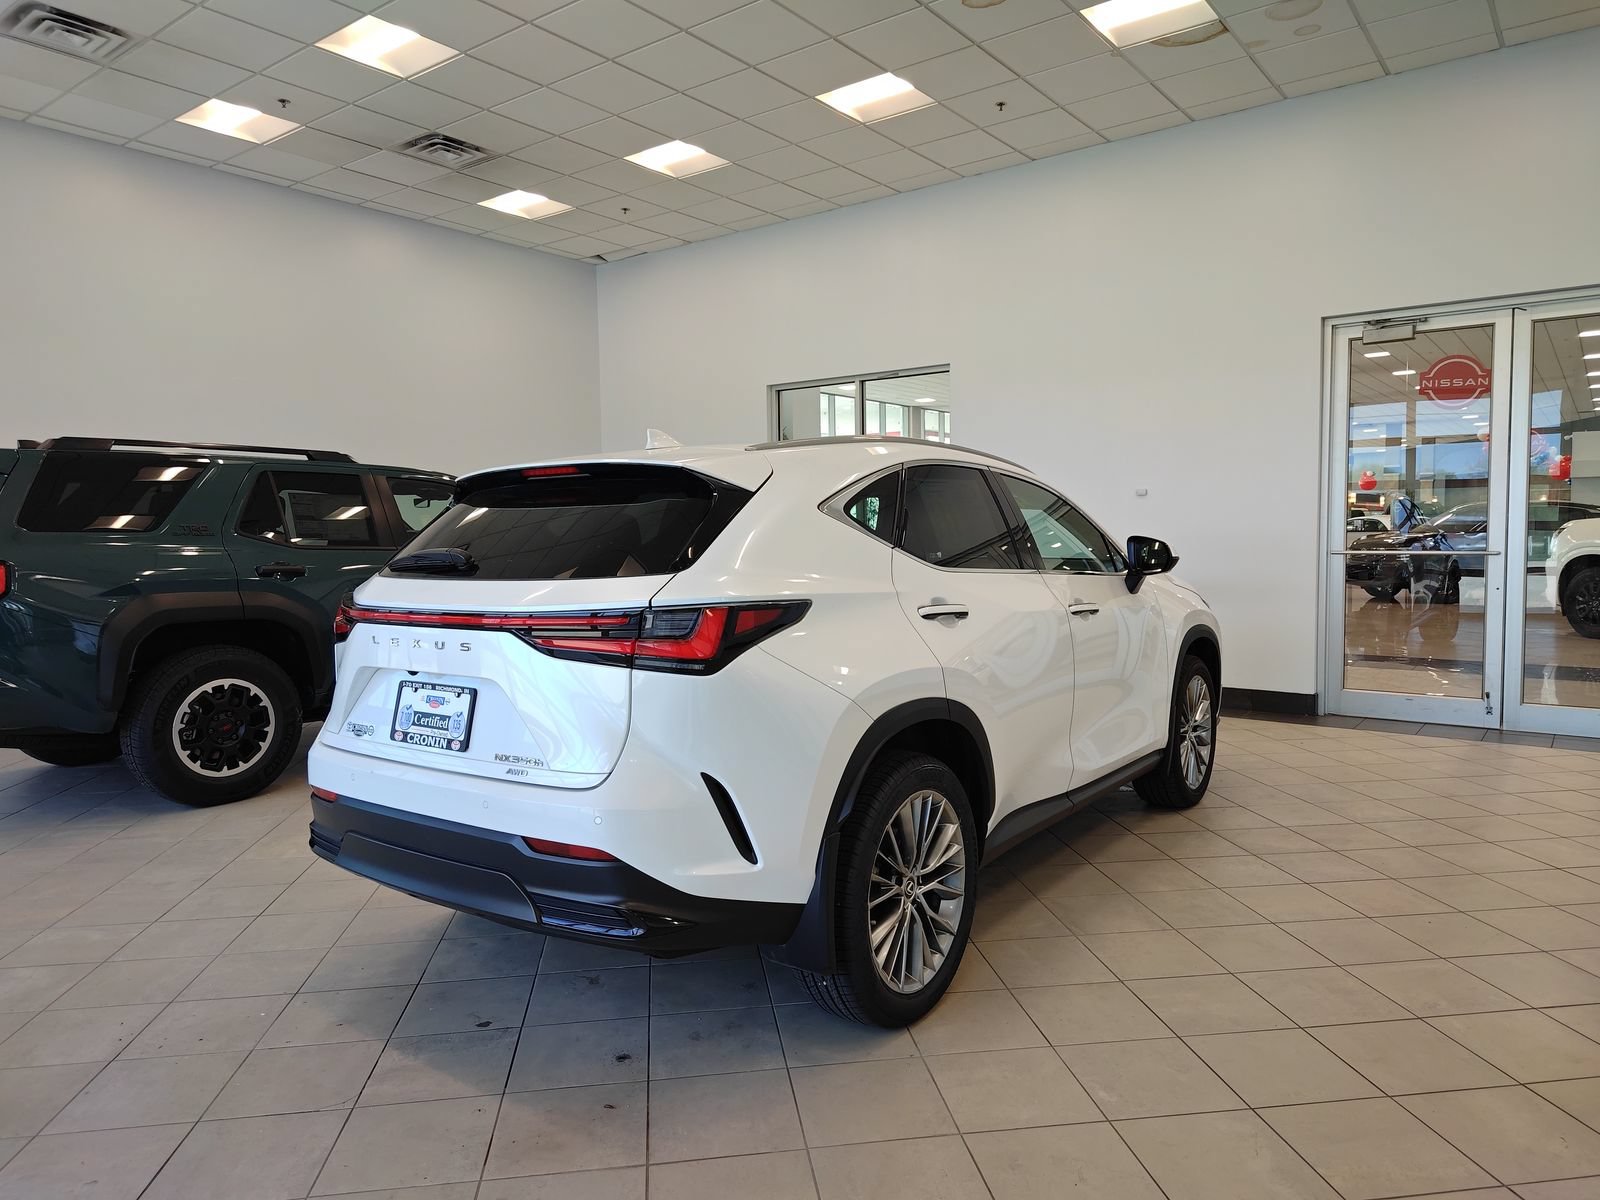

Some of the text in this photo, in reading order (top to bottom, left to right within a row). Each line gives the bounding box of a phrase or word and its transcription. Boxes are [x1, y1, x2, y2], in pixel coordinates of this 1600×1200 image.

[1422, 377, 1489, 388] NISSAN
[372, 635, 472, 652] LEXUS
[414, 714, 449, 729] Certified
[407, 733, 448, 749] CRONIN
[505, 768, 529, 777] AWD
